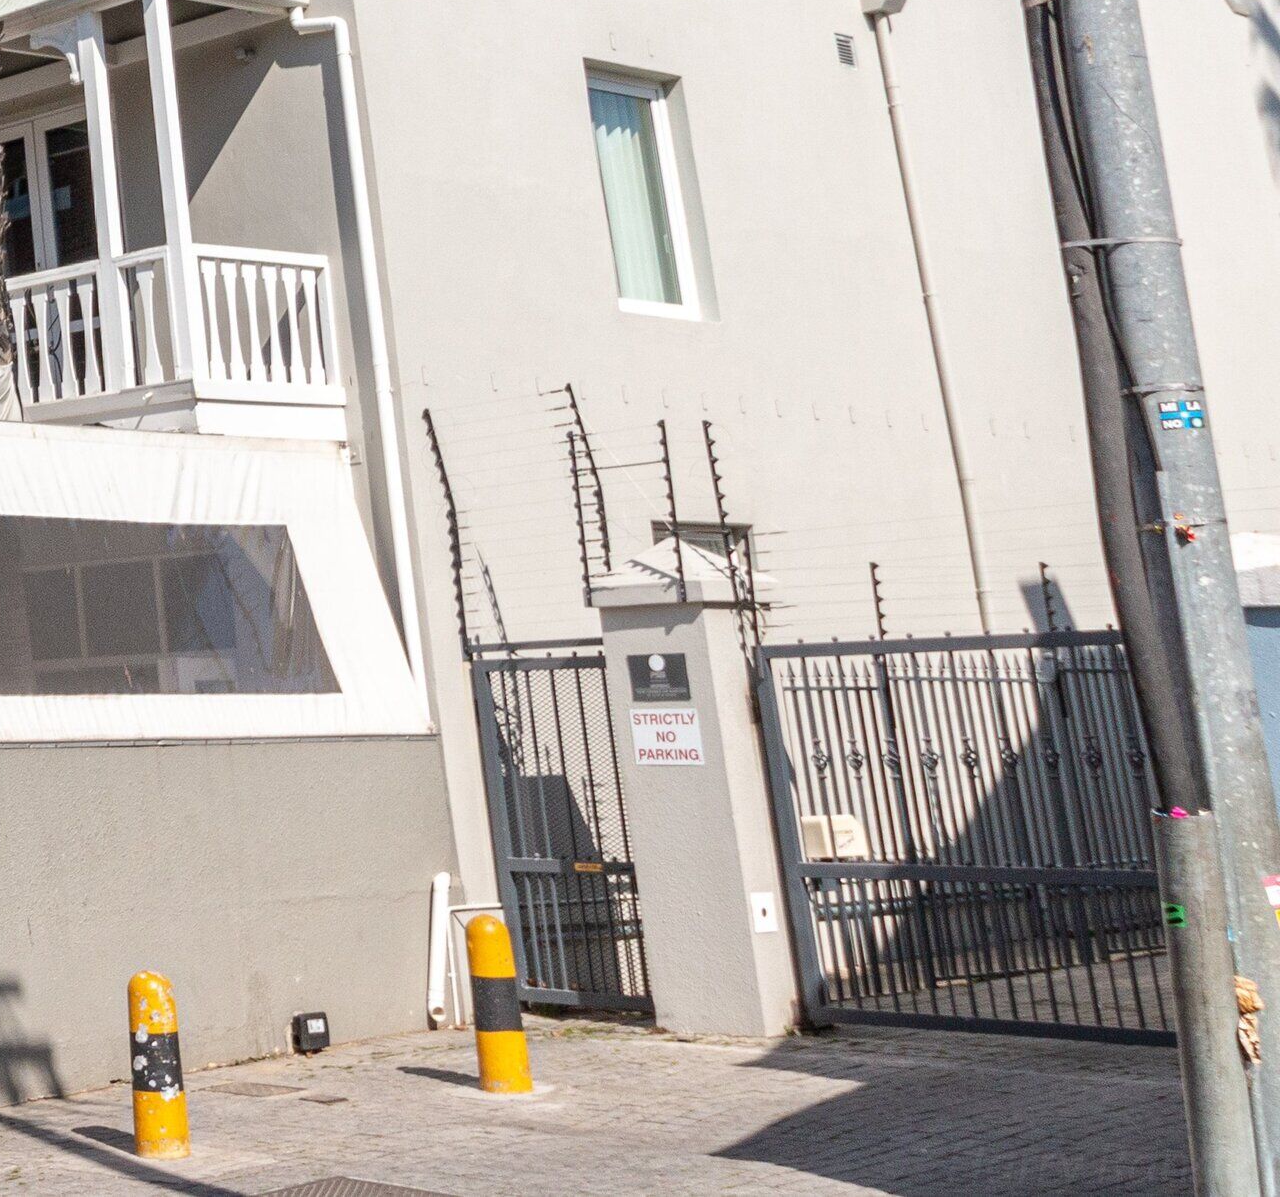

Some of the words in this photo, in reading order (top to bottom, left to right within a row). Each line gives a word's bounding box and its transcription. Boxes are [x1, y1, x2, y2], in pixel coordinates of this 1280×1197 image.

[633, 713, 695, 725] STRICTLY
[656, 731, 676, 742] NO
[639, 748, 699, 760] PARKING
